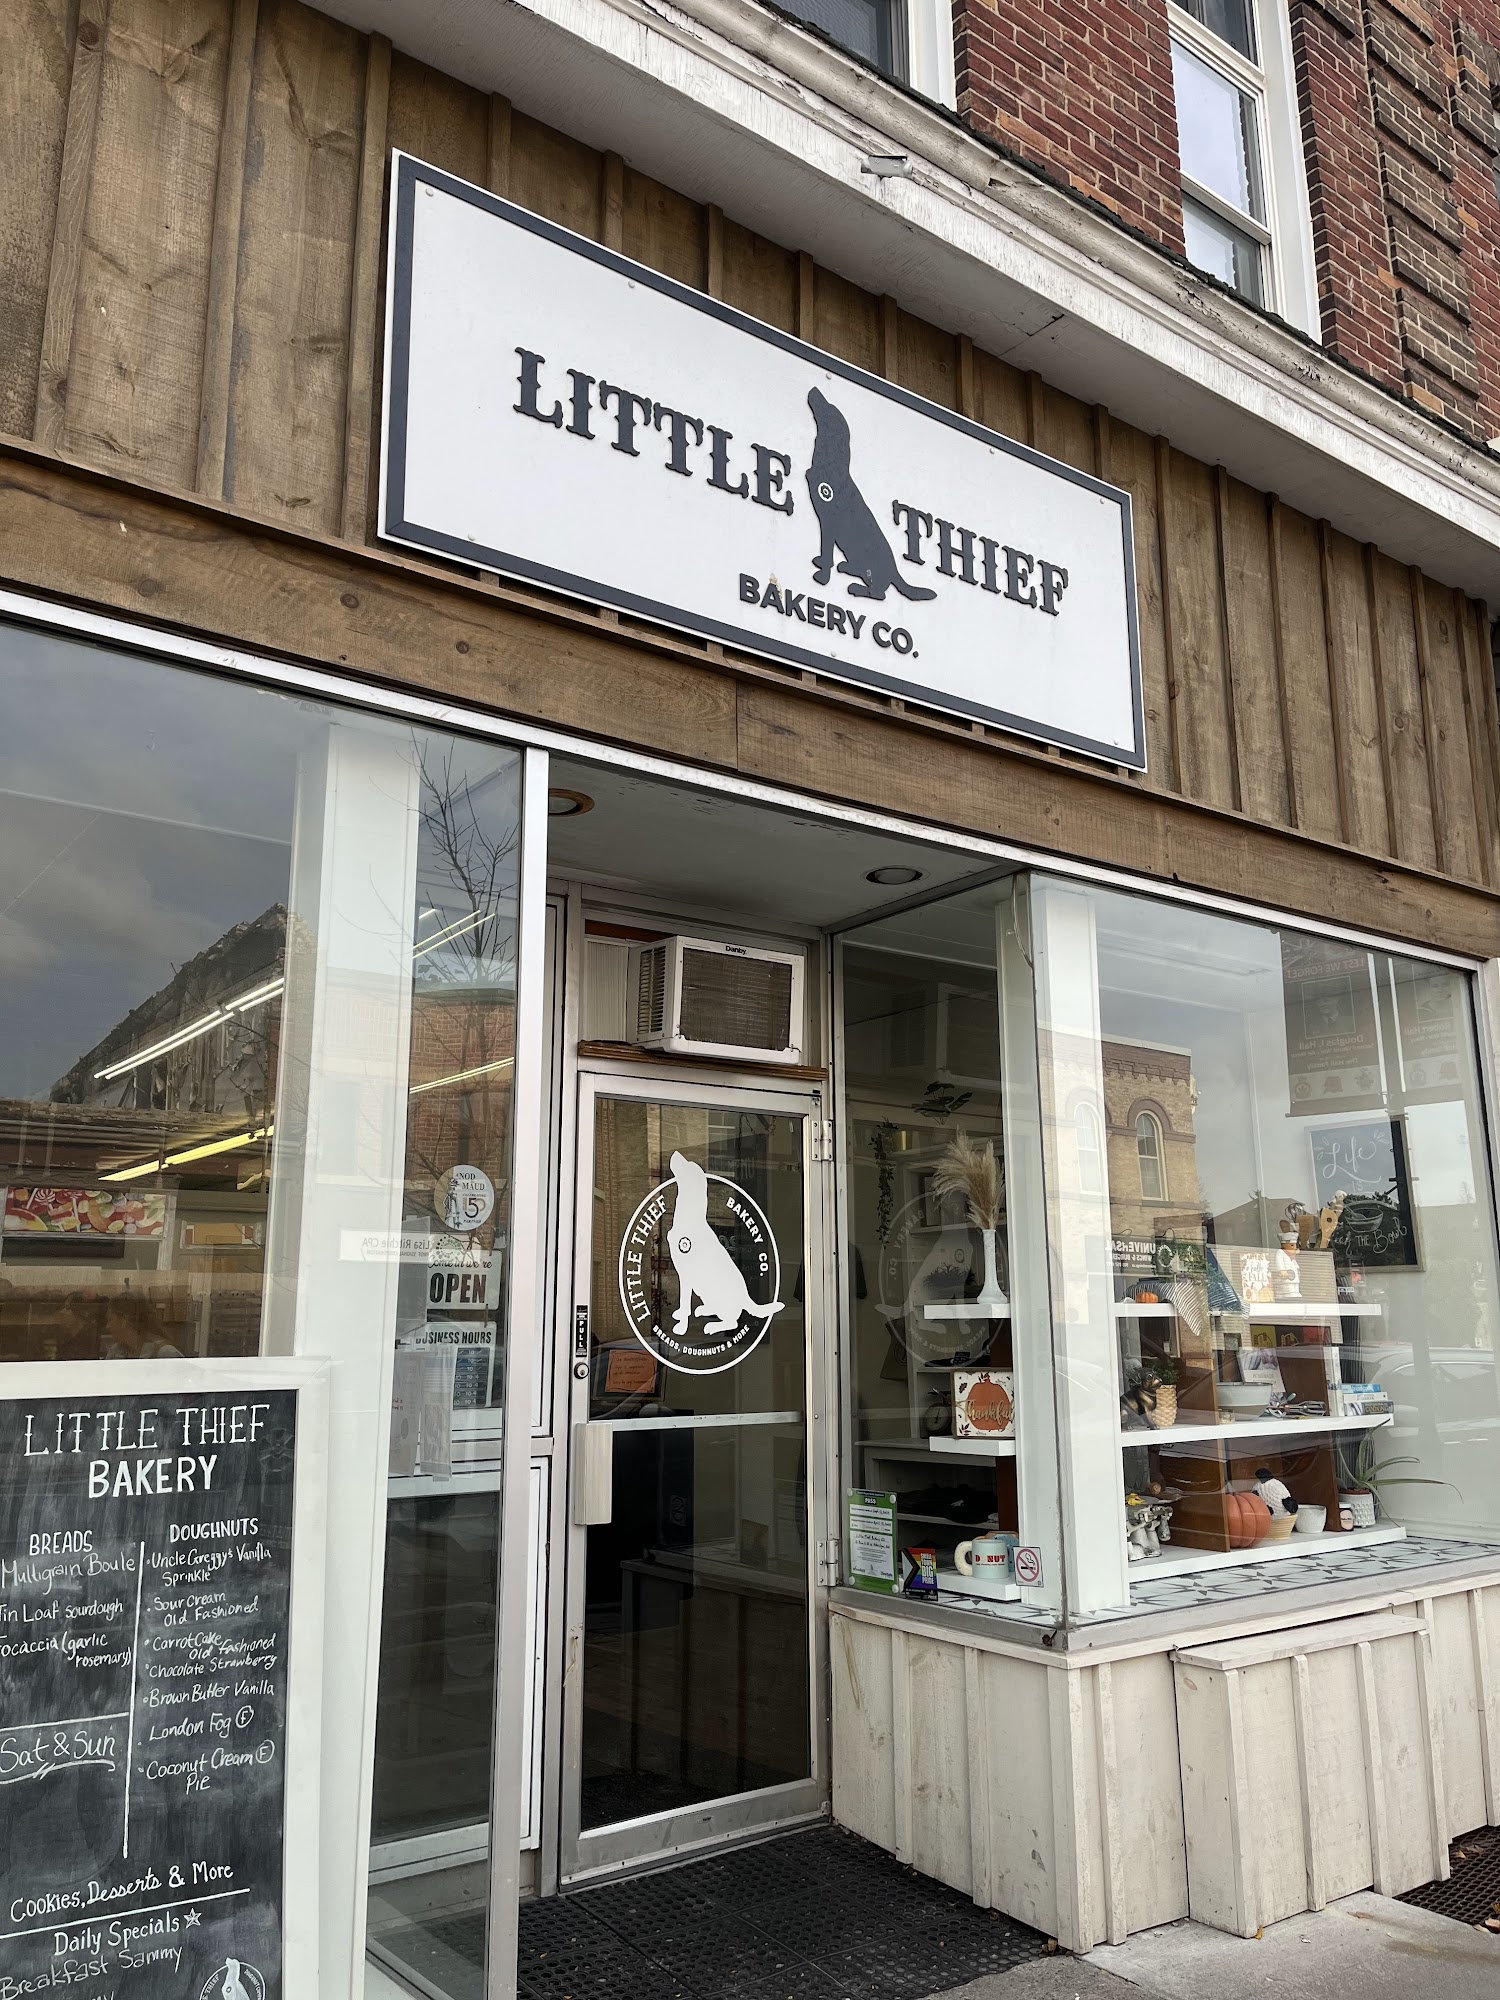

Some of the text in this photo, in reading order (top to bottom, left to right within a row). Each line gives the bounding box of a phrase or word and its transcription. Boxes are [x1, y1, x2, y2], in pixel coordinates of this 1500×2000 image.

[512, 346, 1069, 616] LITTLE THIEF
[739, 573, 919, 658] BAKERY CO.
[1322, 1136, 1380, 1181] Life
[462, 1182, 484, 1190] MAUD
[631, 1195, 667, 1247] THIEF
[726, 1196, 764, 1244] BAKERY
[758, 1253, 769, 1277] CO.
[1373, 1217, 1407, 1254] Bowl
[430, 1272, 487, 1304] OPEN
[627, 1251, 651, 1323] LITTLE
[462, 1332, 492, 1344] HOURS
[652, 1324, 680, 1352] BREADS,
[682, 1344, 726, 1356] DOUGHNUTS
[732, 1324, 750, 1344] MORE
[24, 1404, 270, 1456] LITTLE THIEF
[89, 1454, 218, 1498] BAKERY
[29, 1530, 93, 1556] BREADS
[170, 1518, 258, 1543] DOUGHNUTS
[82, 1552, 136, 1576] Boule
[152, 1551, 186, 1568] Uncle
[236, 1542, 272, 1562] Vanilla
[987, 1554, 1005, 1562] NUT
[922, 1566, 934, 1578] BIG
[23, 1600, 60, 1622] Loaf
[154, 1597, 185, 1611] Sour
[164, 1595, 258, 1627] Old Fashioned
[61, 1630, 108, 1660] (garlic
[75, 1646, 132, 1668] rosemary)
[152, 1633, 194, 1651] Carrot
[188, 1645, 213, 1660] Old
[210, 1652, 278, 1672] Strawberry
[150, 1680, 274, 1708] Brown Butter Vanilla
[149, 1717, 204, 1741] London
[210, 1712, 232, 1738] Fog
[0, 1730, 115, 1772] Sat & Sun
[146, 1753, 208, 1780] Coconut
[210, 1748, 252, 1770] Cream
[87, 1867, 162, 1906] Desserts
[168, 1866, 186, 1888] &
[192, 1861, 234, 1885] More
[54, 1911, 180, 1956] Daily Specials
[0, 1946, 182, 2000] Breakfast Sammy
